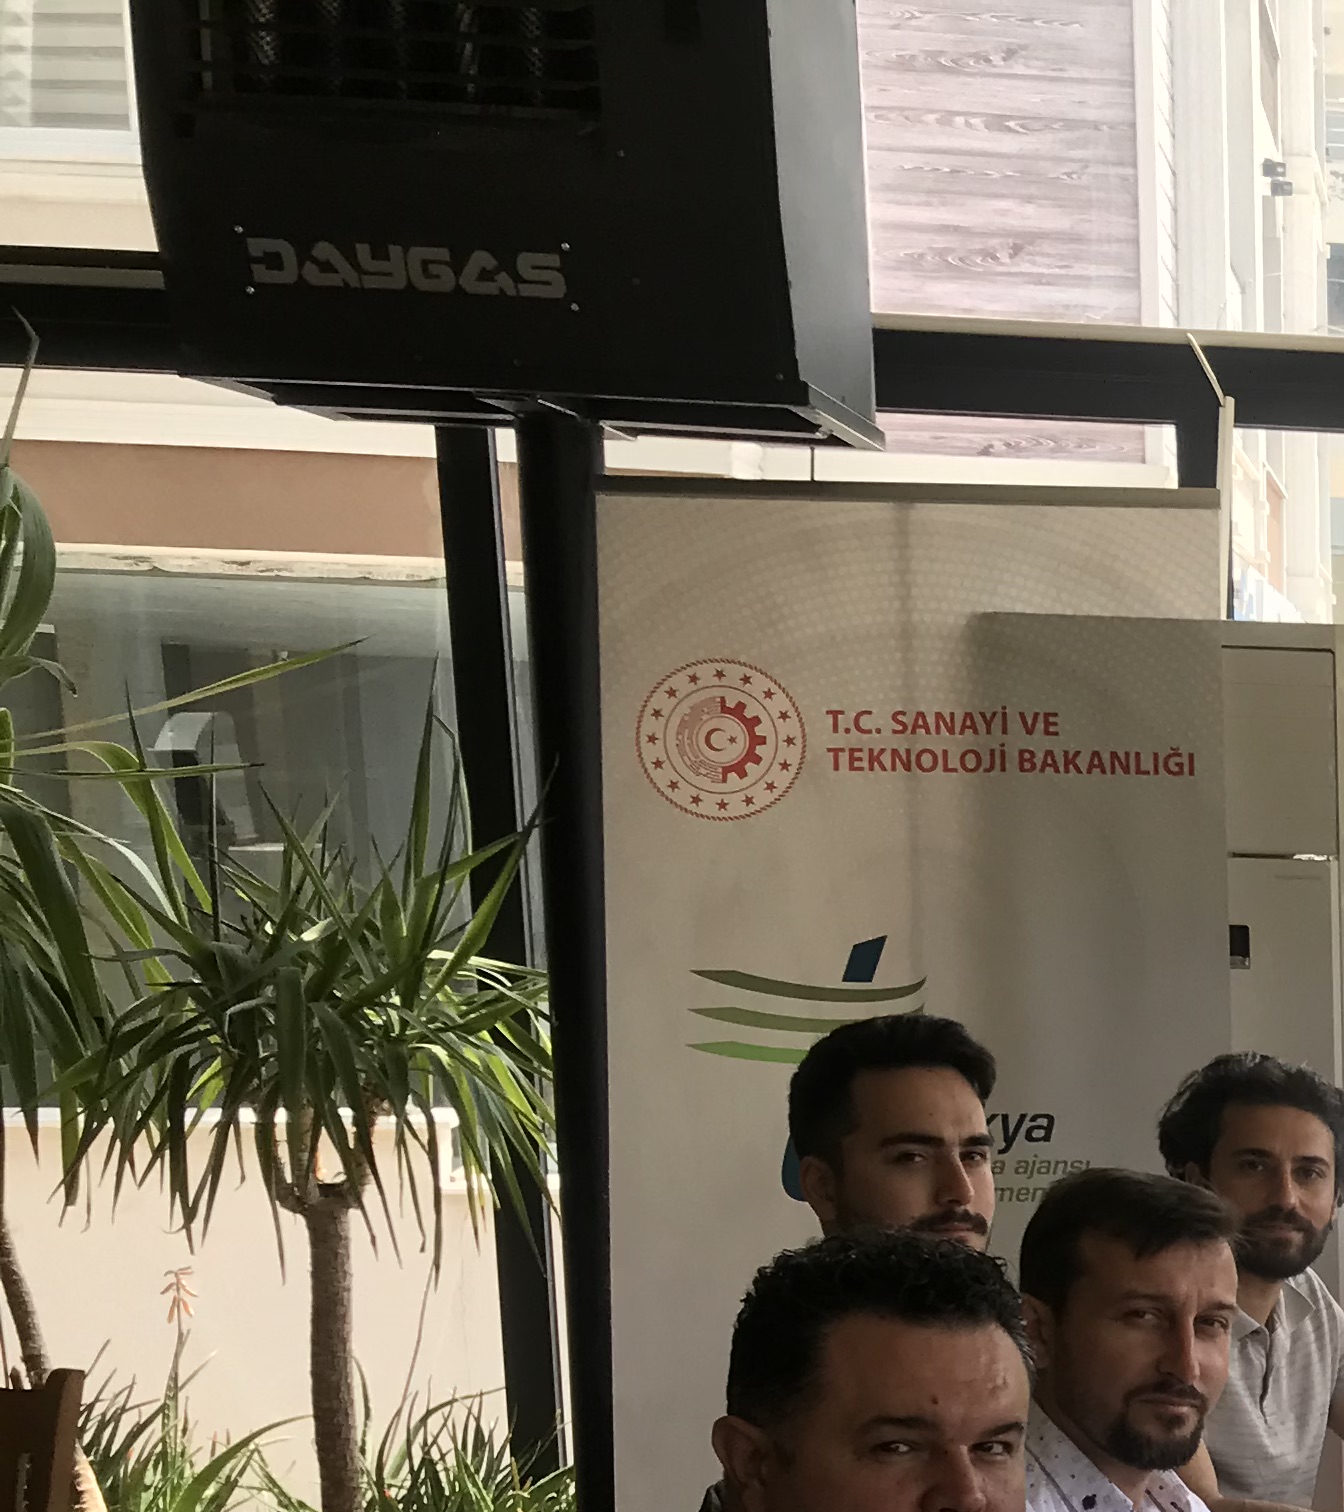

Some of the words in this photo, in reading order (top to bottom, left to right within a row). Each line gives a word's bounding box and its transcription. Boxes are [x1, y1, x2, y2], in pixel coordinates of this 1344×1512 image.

[825, 709, 881, 736] T.C.
[890, 705, 1009, 737] SANAYİ
[1018, 712, 1060, 737] VE
[825, 743, 1007, 774] TEKNOLOJİ
[1017, 746, 1196, 777] BAKANLIĞI
